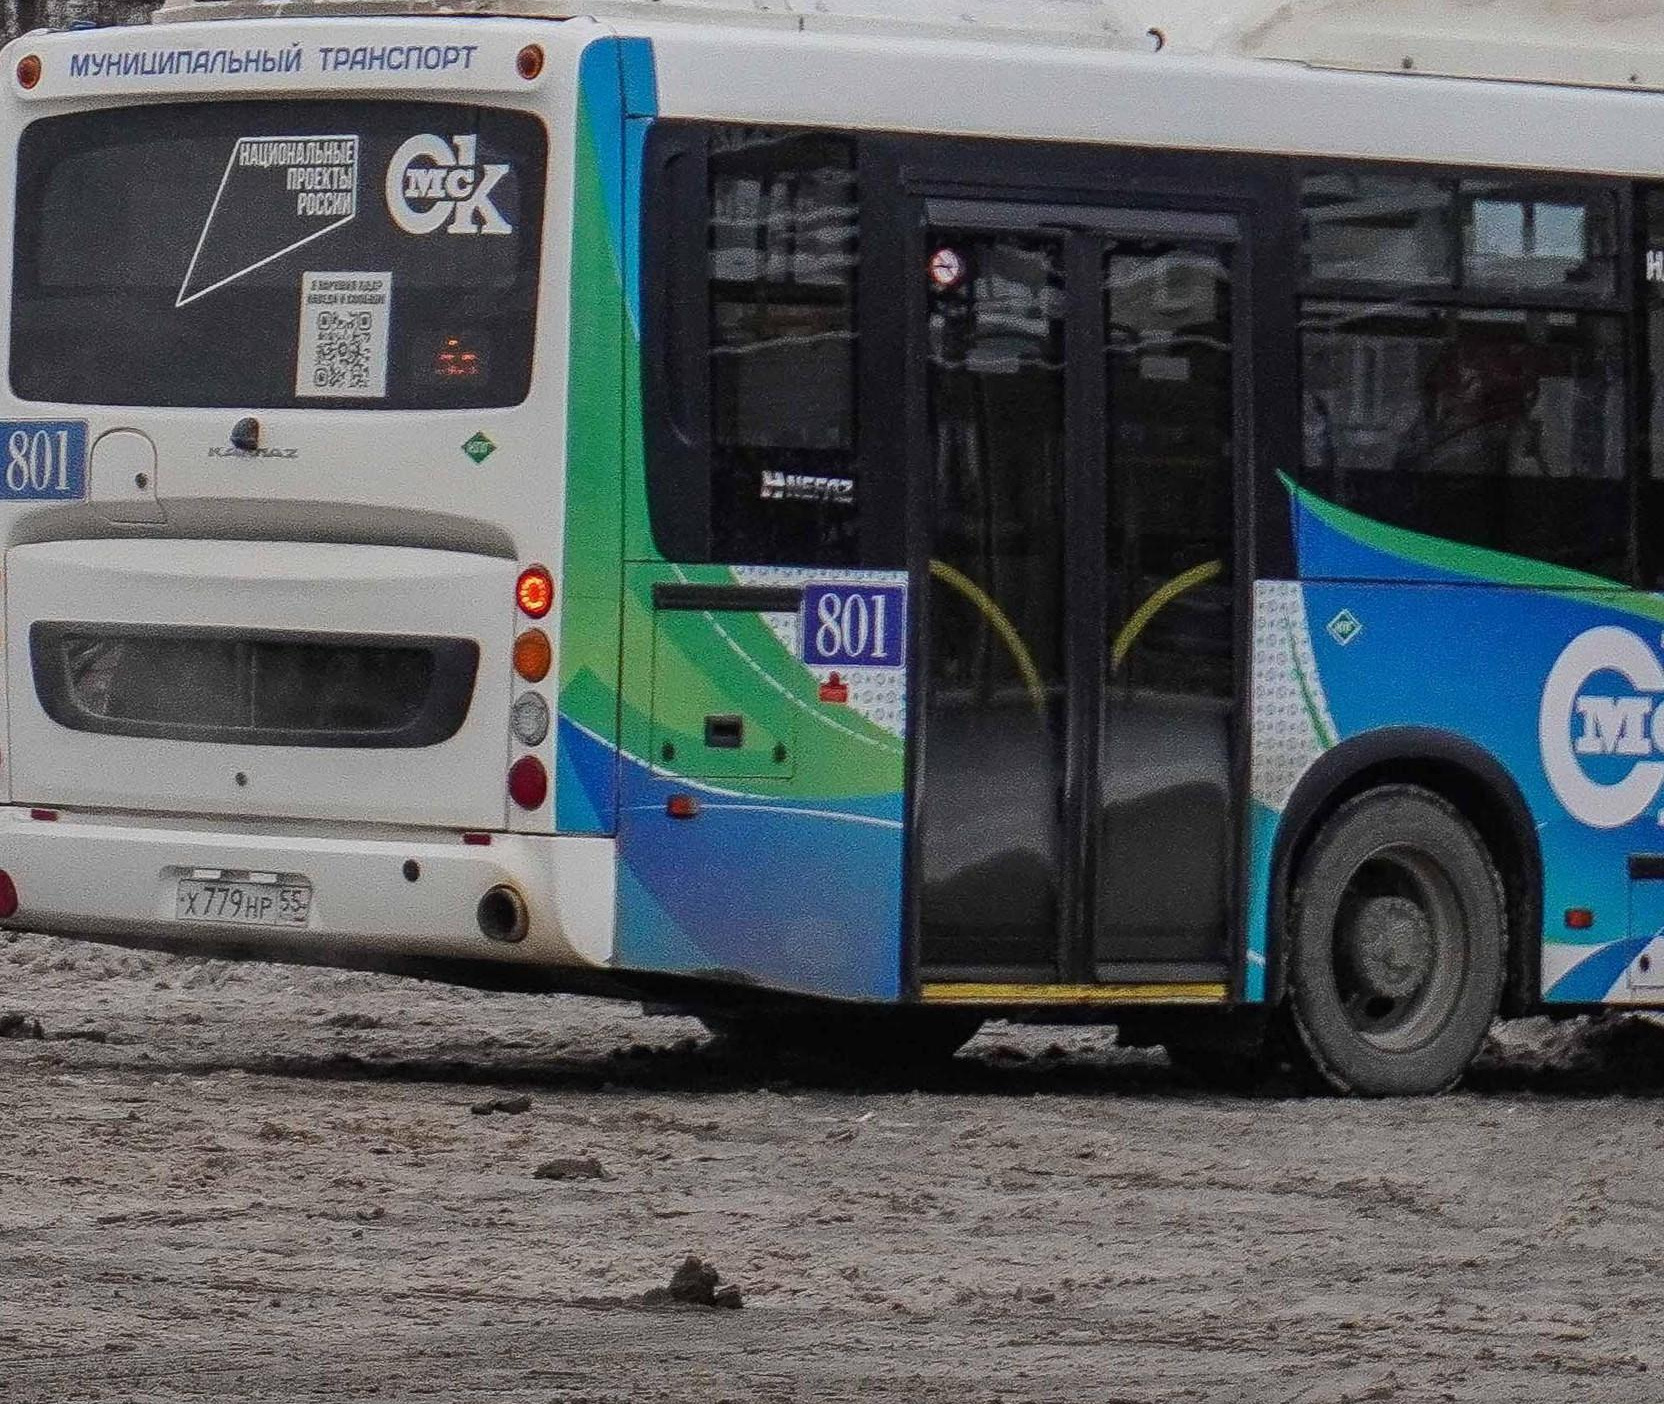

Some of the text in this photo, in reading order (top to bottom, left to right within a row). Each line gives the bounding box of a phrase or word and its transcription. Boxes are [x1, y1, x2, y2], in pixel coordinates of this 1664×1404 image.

[69, 42, 478, 78] МУНИЦИПАЛЬНЫЙ ТРАНСПОРТ
[238, 142, 355, 168] НАЦИОНАЛЬНЫЕ
[285, 166, 353, 191] ПРОЕКТЫ
[296, 191, 353, 217] РОССИИ
[5, 428, 71, 492] 801
[815, 592, 888, 659] 801
